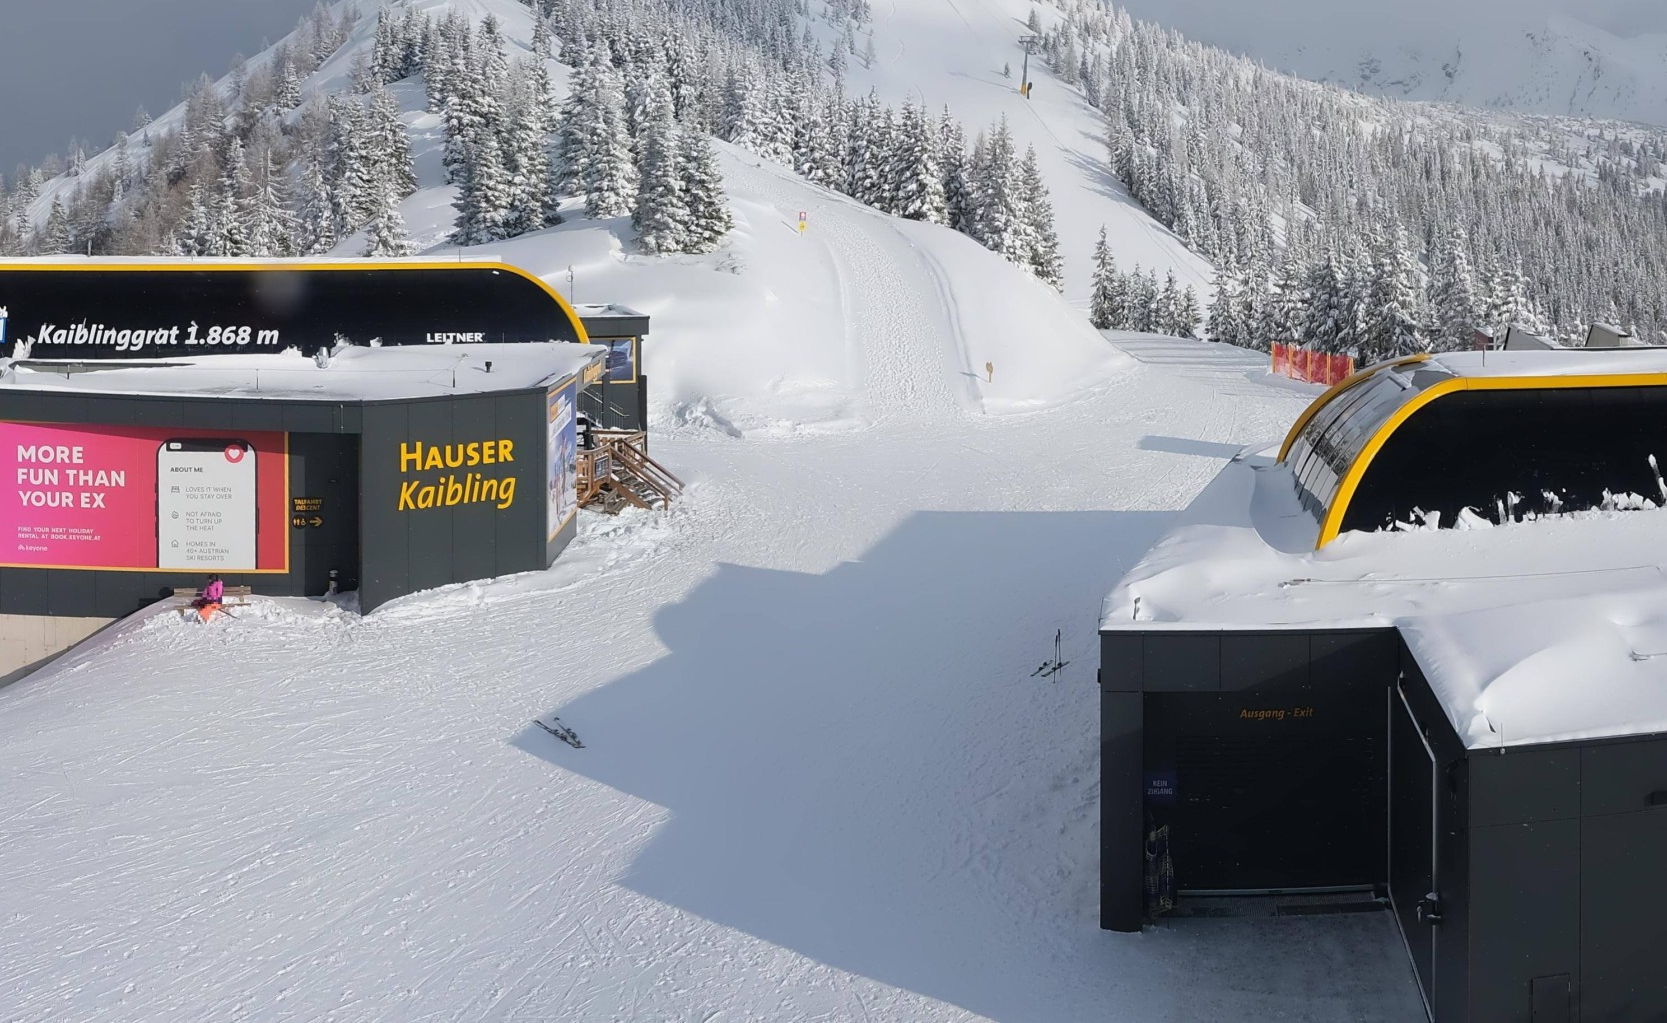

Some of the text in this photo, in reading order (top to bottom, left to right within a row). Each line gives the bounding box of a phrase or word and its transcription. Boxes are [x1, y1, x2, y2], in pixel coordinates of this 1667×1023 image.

[37, 323, 279, 351] Kaiblinggrat 1.868 m
[427, 333, 483, 343] LEITNER
[17, 445, 84, 464] MORE
[400, 439, 514, 472] HAUSER
[17, 468, 125, 487] FUN THAN
[18, 490, 106, 509] YOUR EX
[398, 473, 516, 511] Kaibling
[1240, 708, 1285, 720] Ausgang
[1293, 707, 1314, 717] Exit
